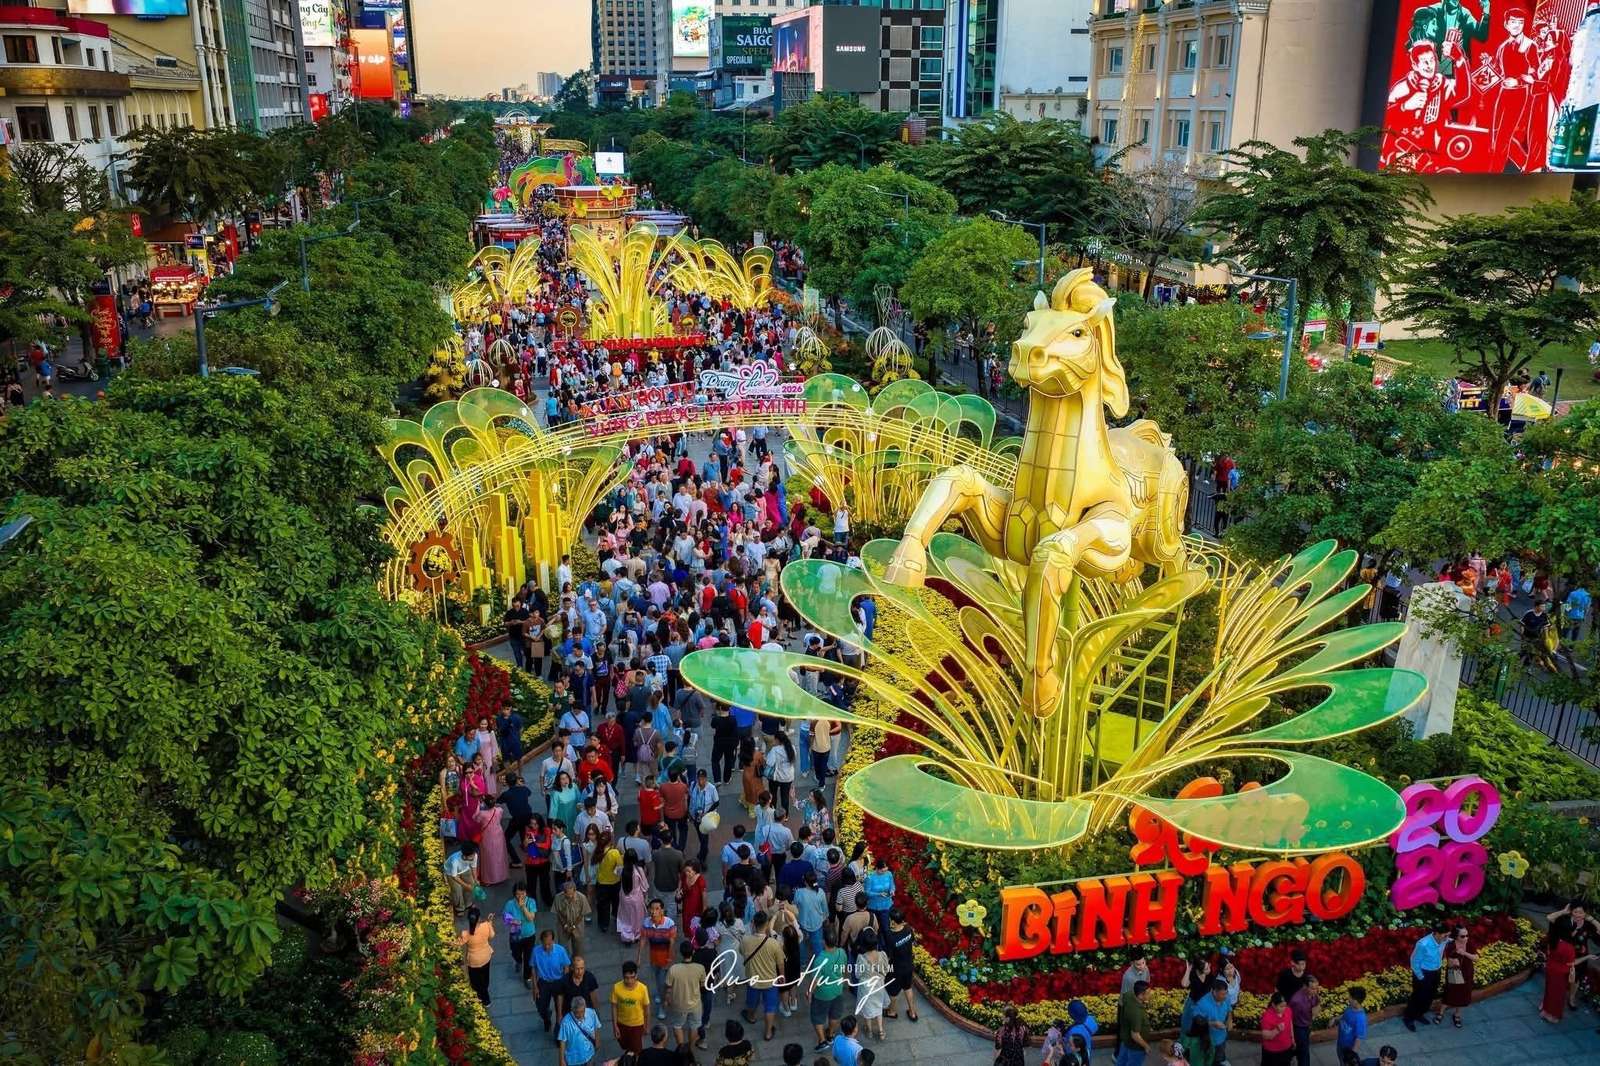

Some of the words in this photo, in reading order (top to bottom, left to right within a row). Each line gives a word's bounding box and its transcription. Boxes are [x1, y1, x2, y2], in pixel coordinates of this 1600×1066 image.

[753, 26, 769, 35] BIA
[835, 45, 867, 53] SAMSUNG
[781, 385, 803, 393] 2026
